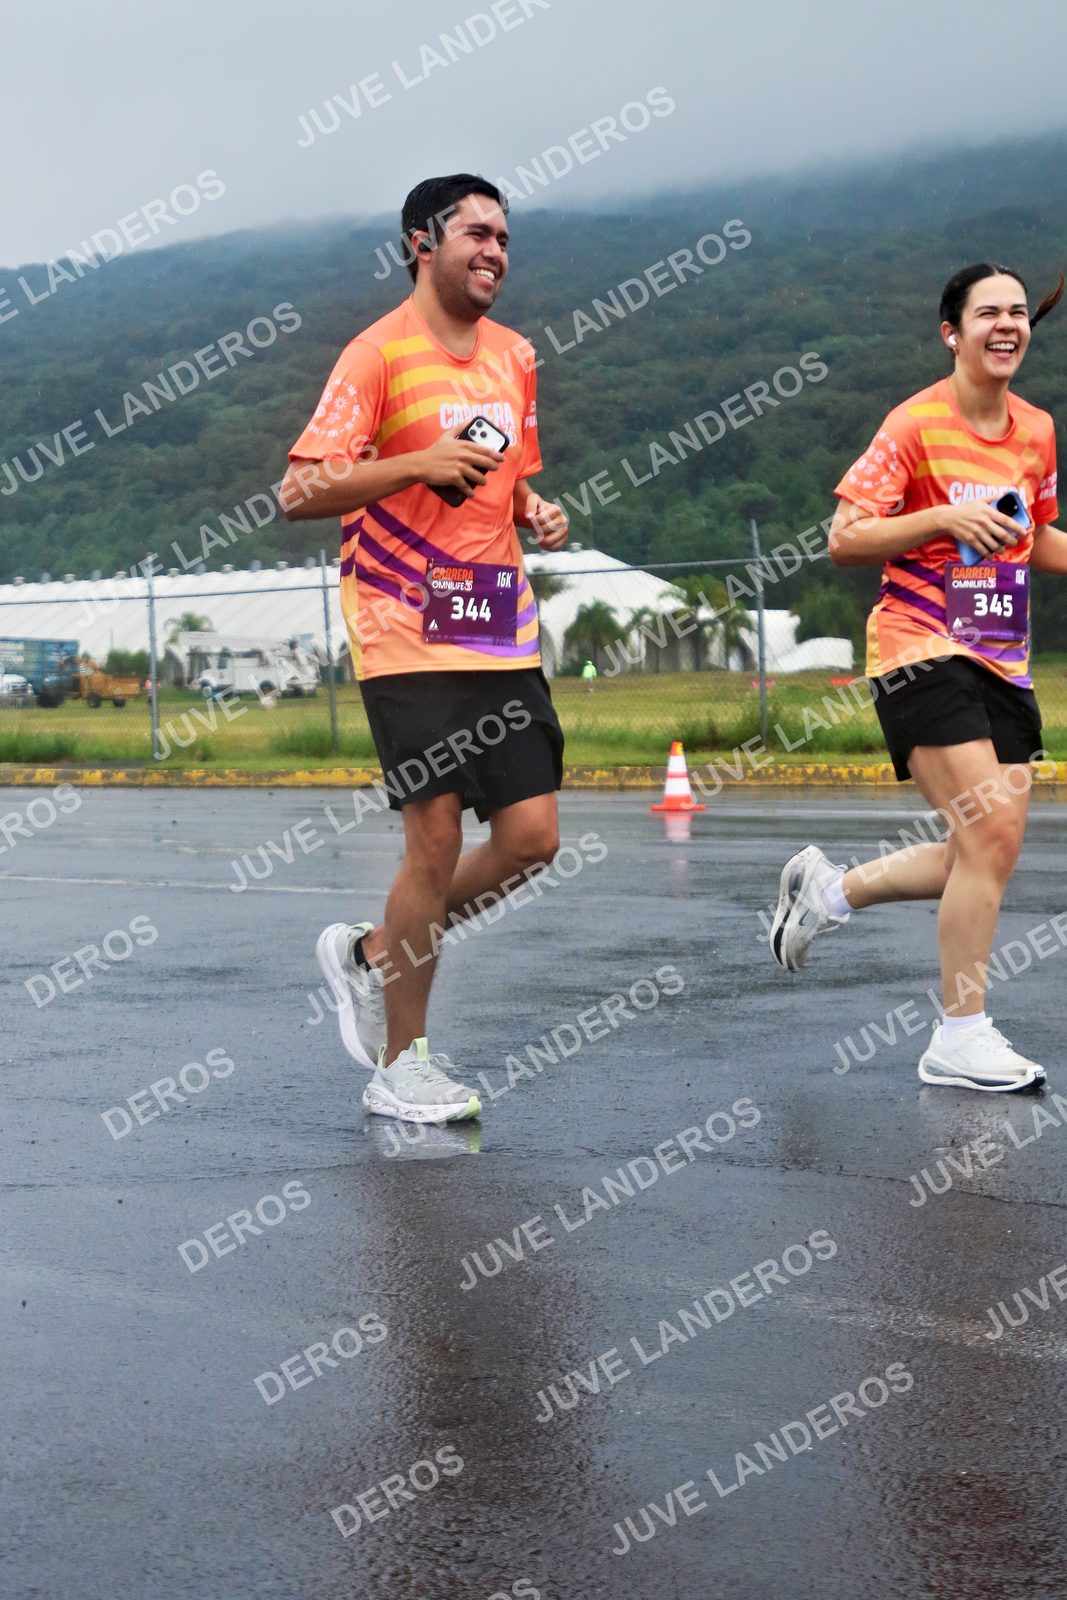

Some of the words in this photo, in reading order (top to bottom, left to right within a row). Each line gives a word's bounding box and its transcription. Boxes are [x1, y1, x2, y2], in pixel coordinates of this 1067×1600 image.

[949, 481, 1027, 507] CARRA
[432, 567, 473, 580] CARRERA
[952, 567, 996, 580] CARRERA
[432, 580, 464, 590] OMNILIFE
[952, 580, 987, 588] OMNILIFE
[451, 596, 491, 621] 344
[973, 593, 1013, 617] 345
